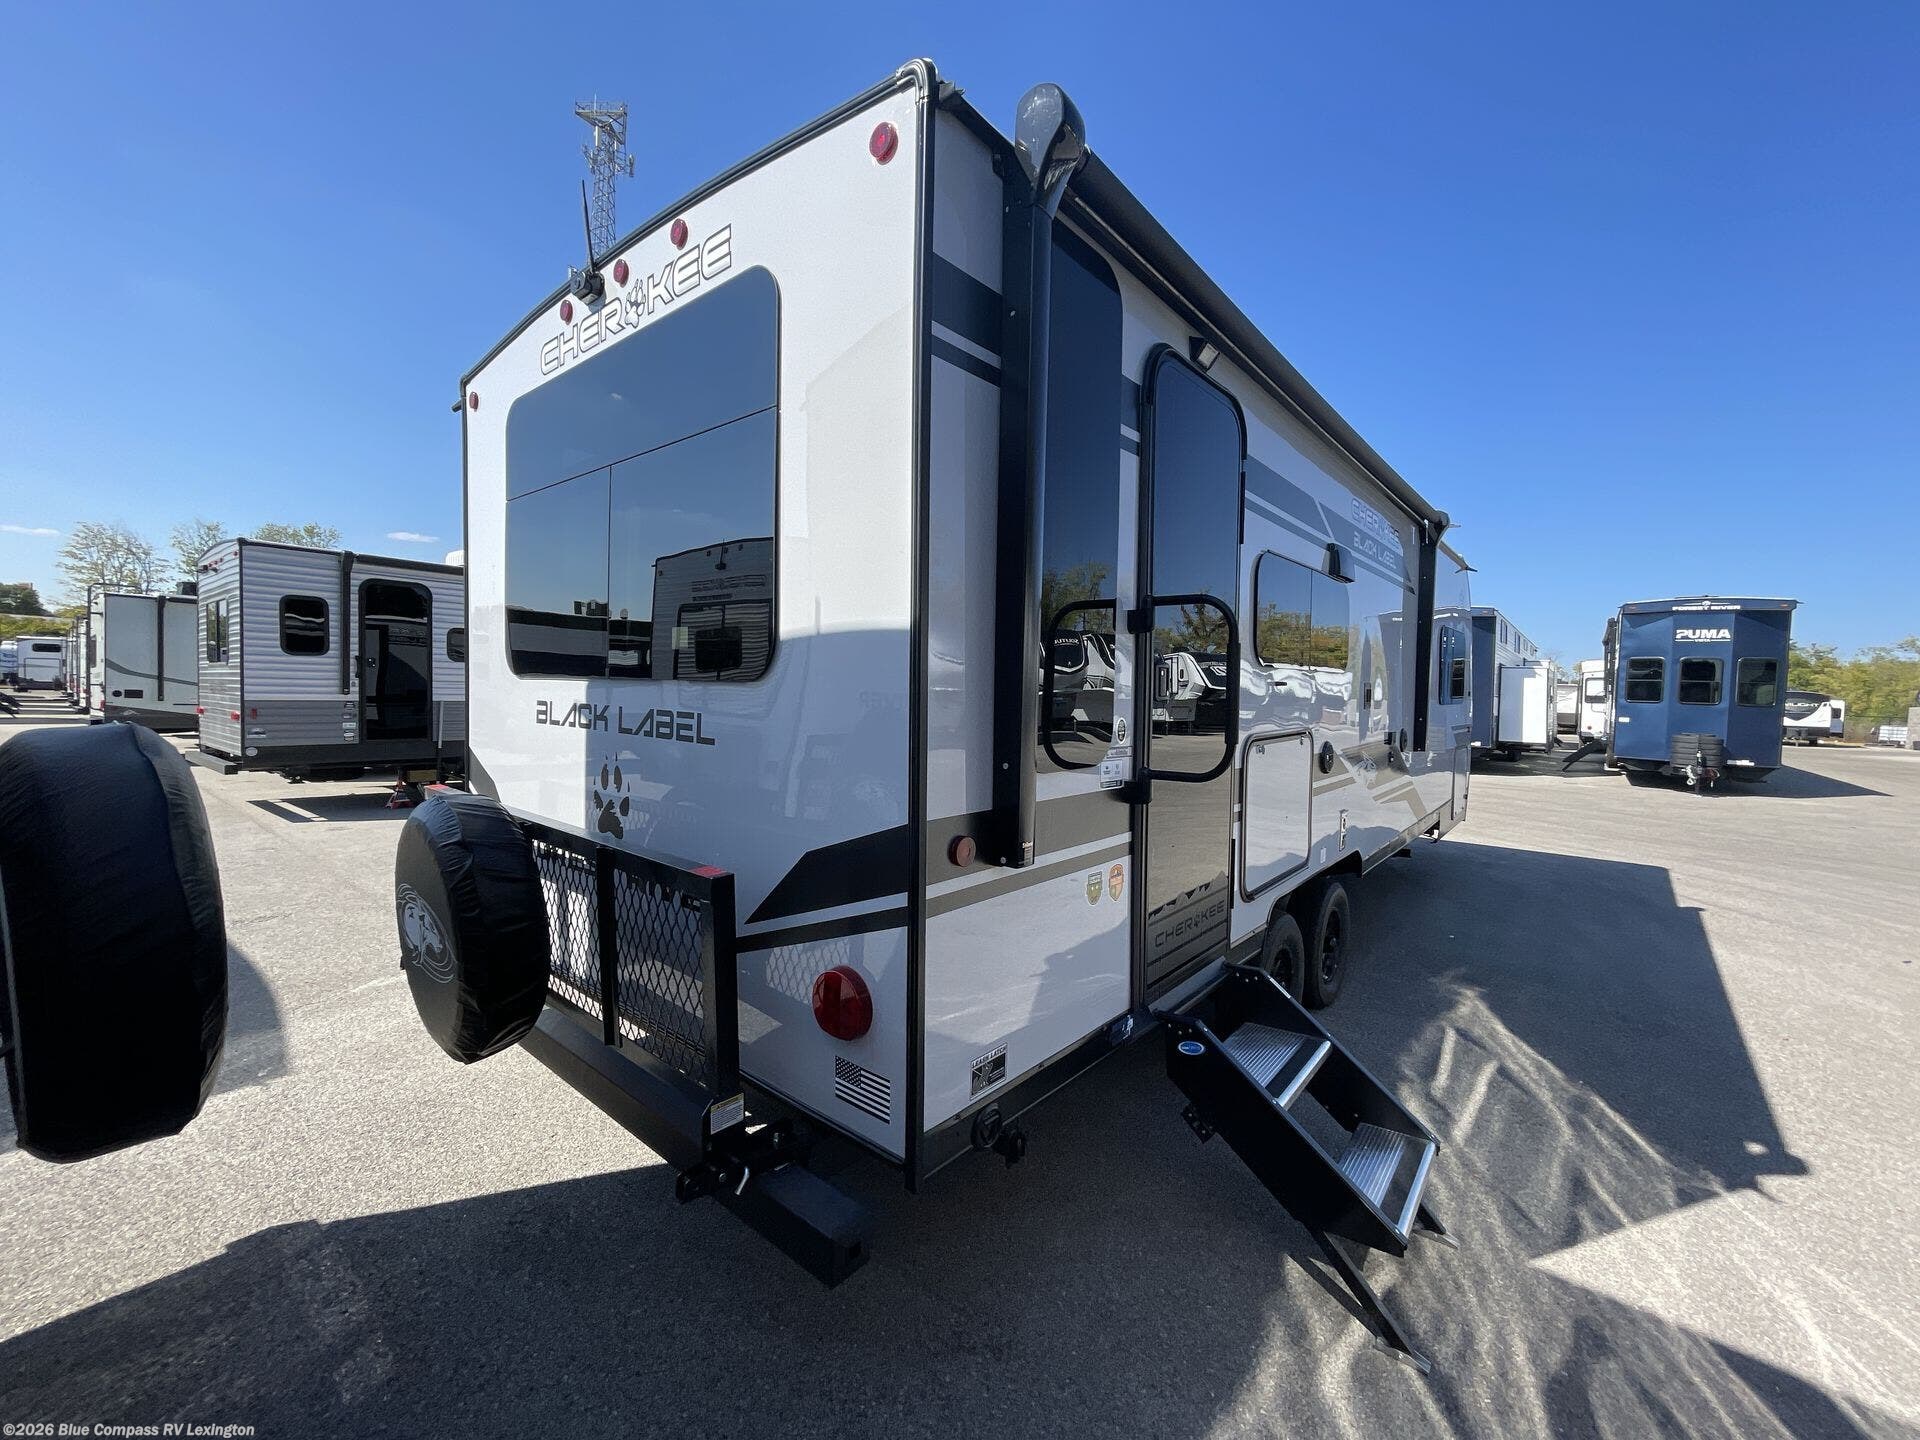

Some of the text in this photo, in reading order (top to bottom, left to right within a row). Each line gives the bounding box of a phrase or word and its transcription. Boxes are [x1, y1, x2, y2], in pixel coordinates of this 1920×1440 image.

[1675, 629, 1731, 639] PUMA
[536, 700, 715, 746] BLACK LABEL
